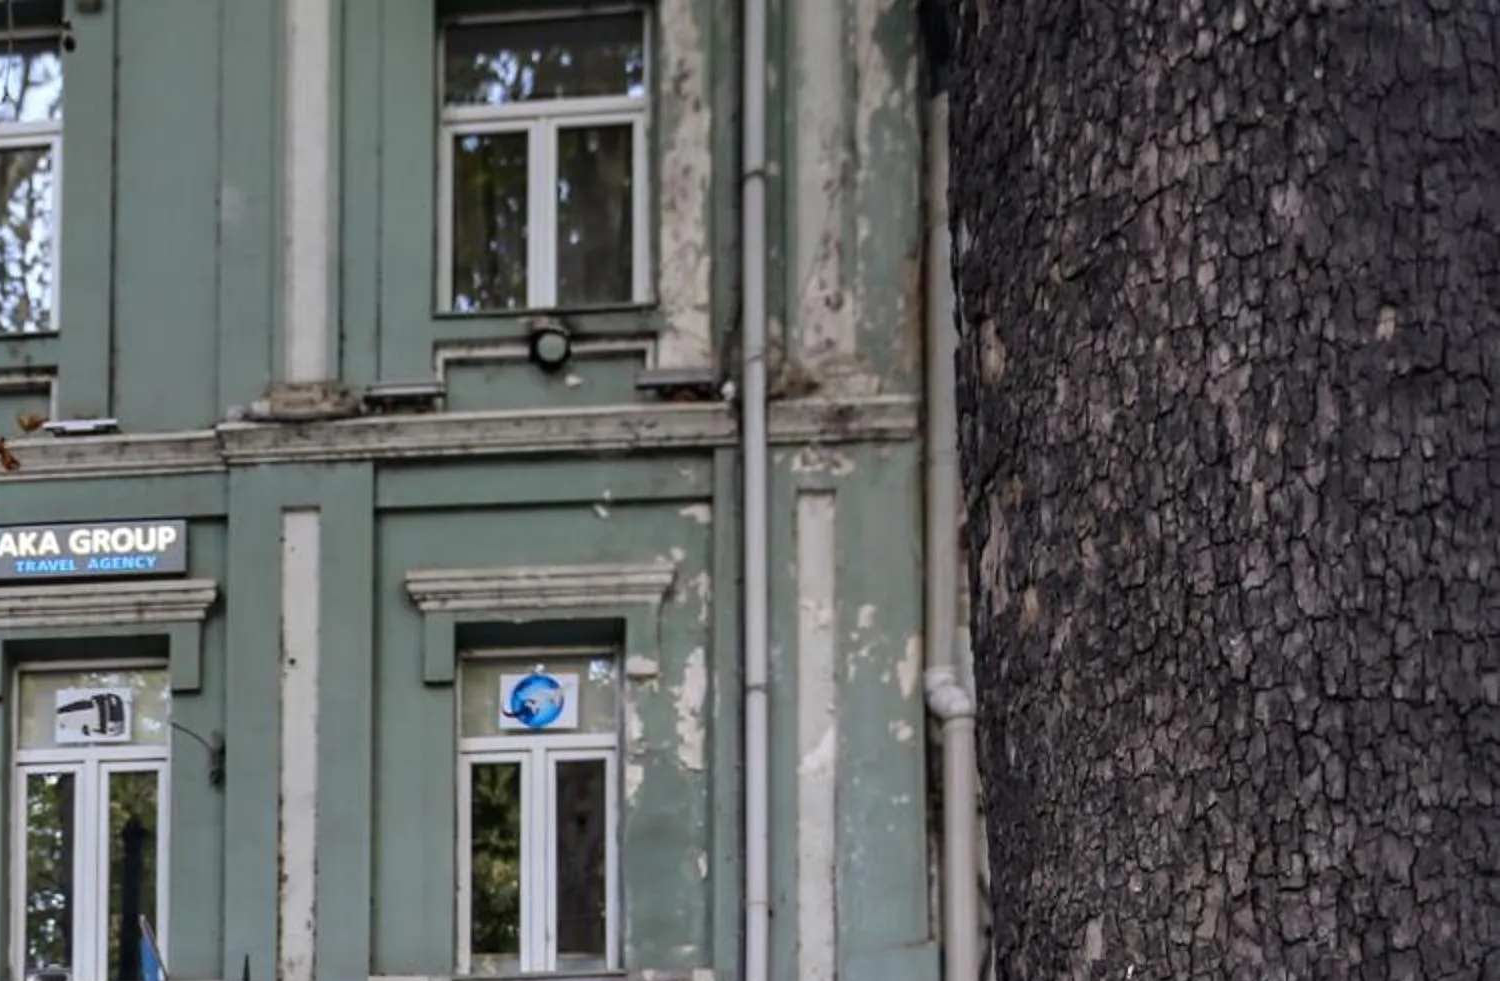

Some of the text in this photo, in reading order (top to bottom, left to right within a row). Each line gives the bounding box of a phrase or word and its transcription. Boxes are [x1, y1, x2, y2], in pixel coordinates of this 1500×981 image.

[69, 526, 176, 554] GROUP
[15, 556, 157, 573] TRAVEL AGENCY
